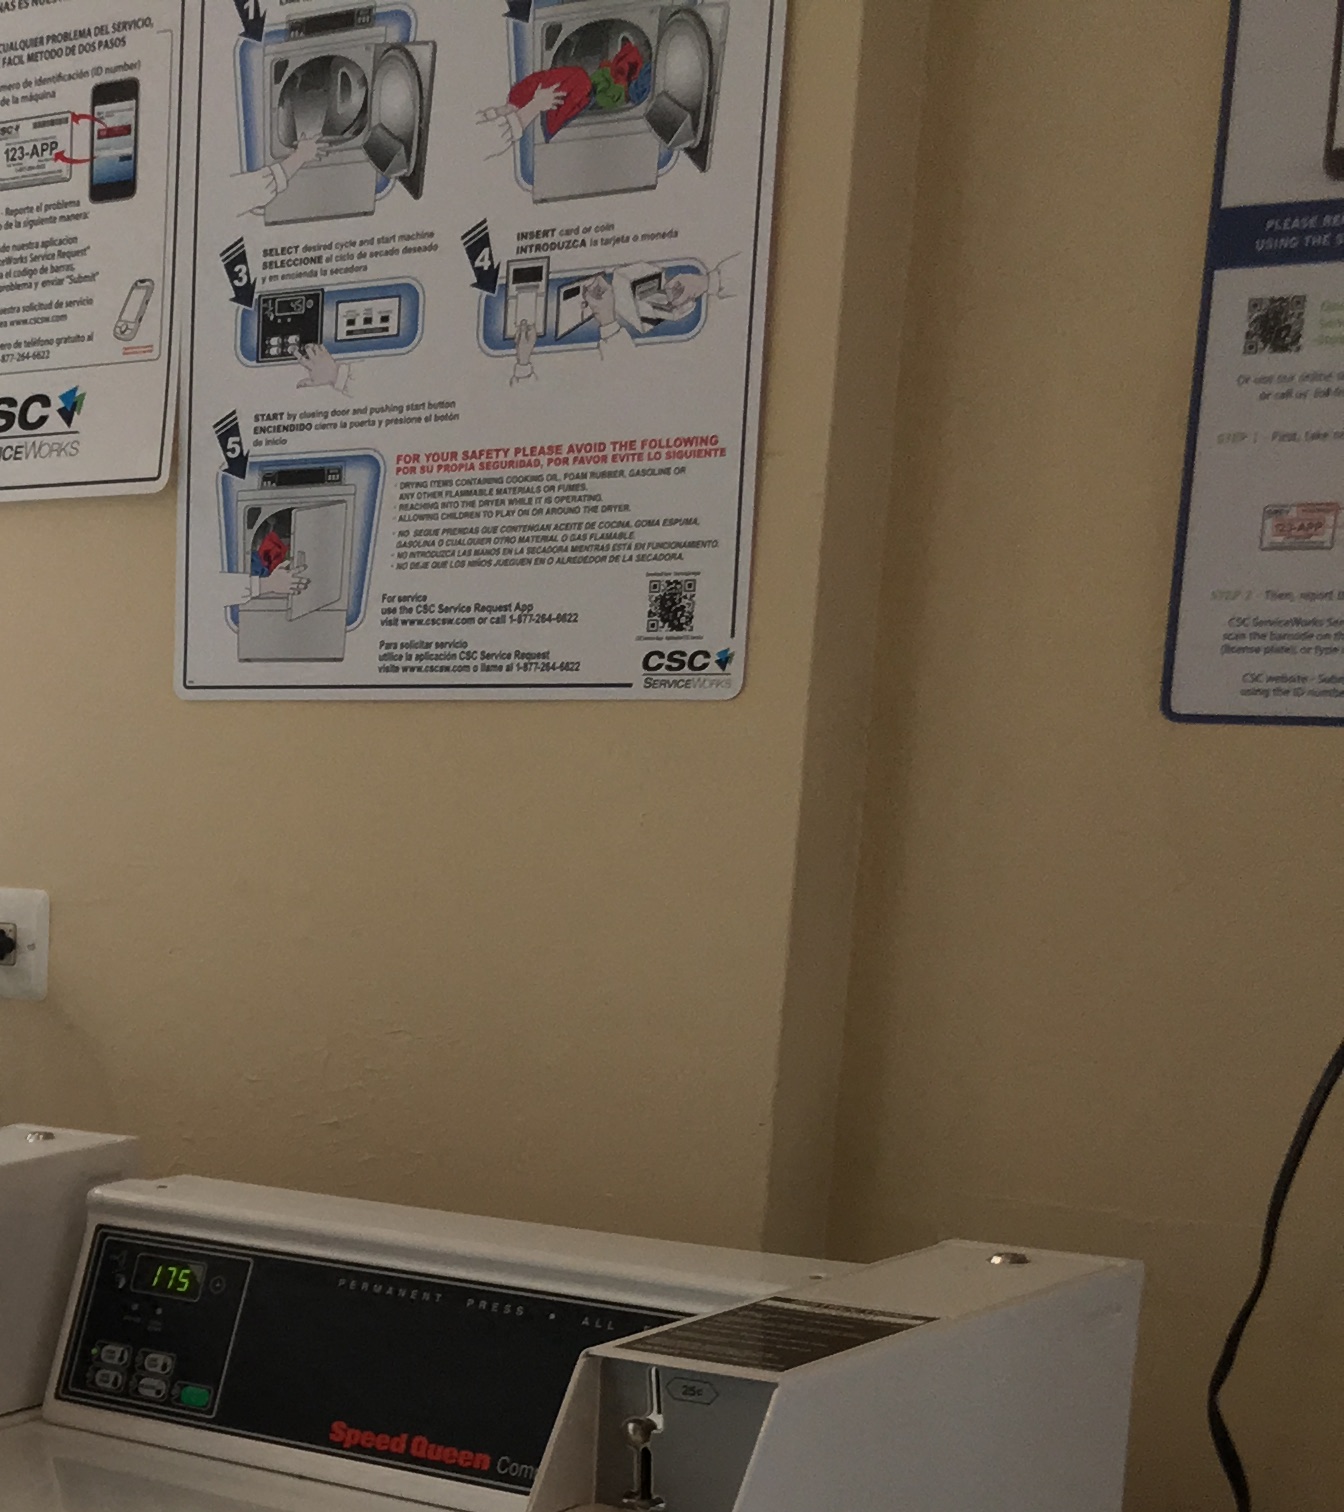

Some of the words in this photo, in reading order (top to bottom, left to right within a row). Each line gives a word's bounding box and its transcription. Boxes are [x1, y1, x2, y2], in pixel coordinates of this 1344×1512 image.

[46, 27, 92, 46] PROBLEMA
[94, 24, 110, 37] DEL
[65, 44, 76, 56] DE
[78, 41, 96, 54] DOS
[98, 36, 126, 50] PASOS
[4, 140, 58, 163] 123-APP
[517, 228, 556, 241] INSERT
[263, 245, 299, 257] SELECT
[516, 238, 586, 255] INTRODUZCA
[262, 255, 323, 270] SELECCIONE
[475, 248, 492, 270] 4
[233, 265, 247, 286] 3
[254, 412, 284, 422] START
[254, 423, 312, 435] ENCIENDIDO
[226, 438, 240, 458] 5
[396, 454, 420, 464] FOR
[425, 452, 458, 463] YOUR
[462, 448, 510, 460] SAFETY
[514, 444, 563, 457] PLEASE
[567, 442, 606, 454] AVOID
[610, 440, 637, 452] THE
[641, 435, 719, 450] FOLLOWING
[396, 467, 416, 475] POR
[420, 466, 433, 474] SU
[437, 462, 475, 473] PROPIA
[479, 458, 543, 471] SEGURIDAD,
[547, 457, 569, 466] POR
[572, 455, 607, 465] FAVOR
[611, 453, 644, 463] EVITE
[647, 452, 661, 461] LO
[665, 448, 726, 460] SIGUIENTE
[416, 604, 435, 613] CSC
[438, 604, 471, 613] Service
[474, 602, 512, 614] Request
[514, 602, 534, 612] App
[459, 651, 477, 660] CSC
[480, 650, 512, 660] Service
[642, 650, 711, 672] CSC
[151, 1264, 191, 1293] 175
[337, 1277, 443, 1303] PERMANENT
[467, 1297, 526, 1318] PRESS
[580, 1315, 616, 1331] ALL
[329, 1420, 409, 1454] Speed
[410, 1435, 491, 1471] Queen
[497, 1456, 539, 1479] Com
